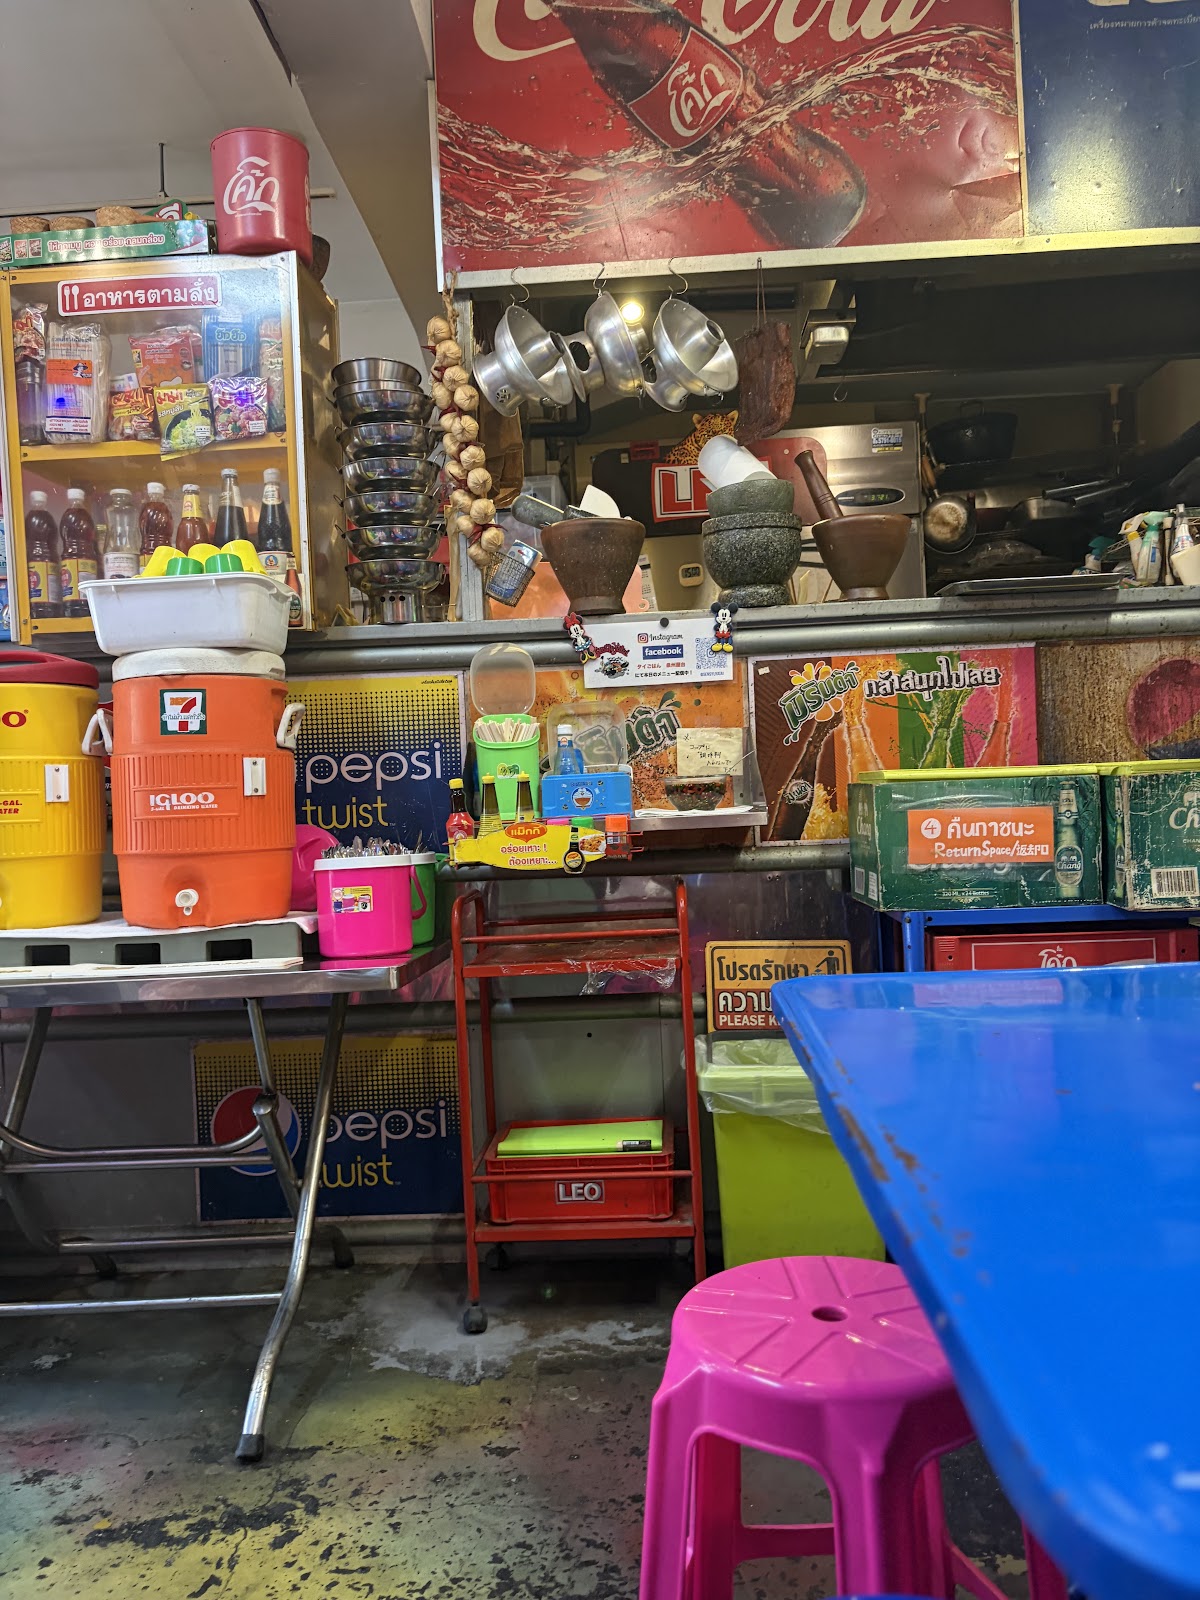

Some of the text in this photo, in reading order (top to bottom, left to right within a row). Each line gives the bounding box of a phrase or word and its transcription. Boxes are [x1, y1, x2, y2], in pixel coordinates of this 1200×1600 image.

[82, 279, 216, 308] อาหารตามสั่ง
[649, 633, 683, 643] Instagram
[645, 647, 682, 656] facebook
[305, 741, 442, 793] pepsi
[150, 791, 215, 810] IGLOO
[302, 796, 389, 829] twist
[1057, 861, 1081, 870] Chang
[716, 956, 809, 981] โปรดรักษา
[719, 1014, 766, 1026] PLEASE
[321, 1154, 394, 1188] wist
[559, 1182, 601, 1201] LEO
